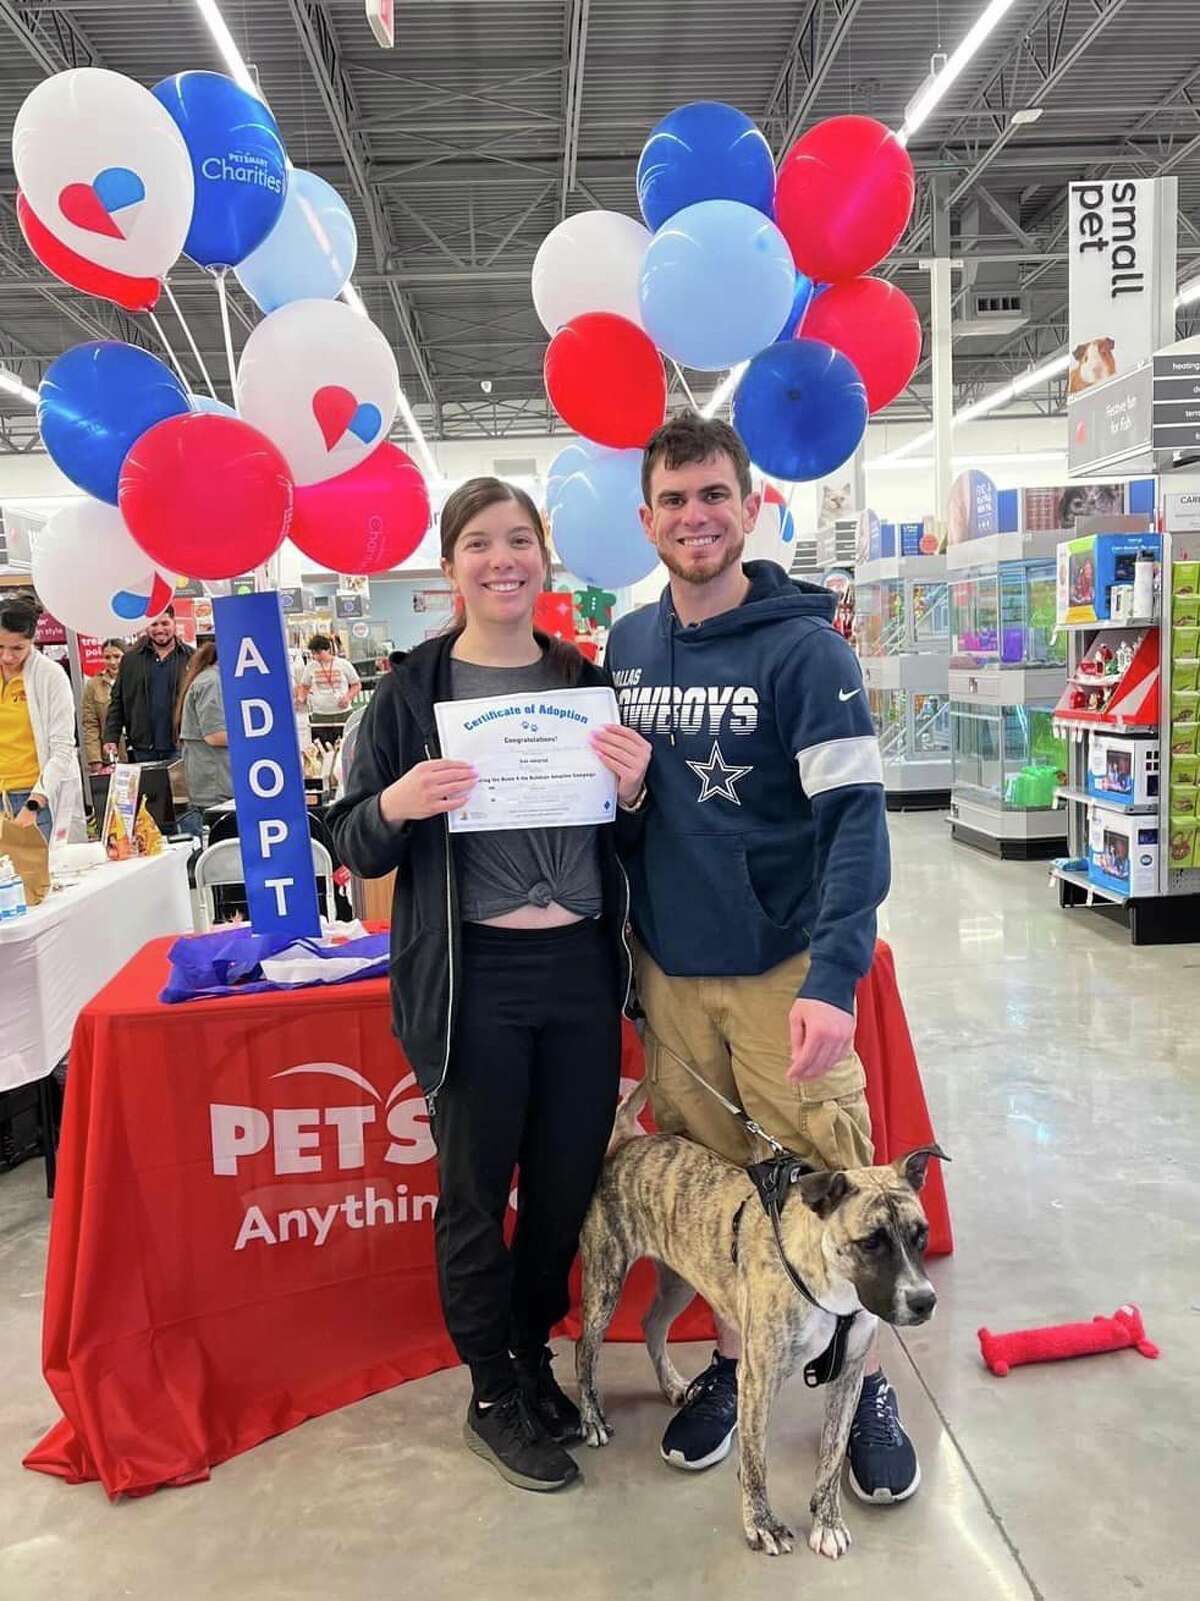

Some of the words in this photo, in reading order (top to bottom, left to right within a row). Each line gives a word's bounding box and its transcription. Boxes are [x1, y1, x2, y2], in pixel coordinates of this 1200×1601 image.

[202, 157, 281, 194] Charities
[1071, 185, 1109, 253] pet
[1111, 182, 1144, 298] small
[612, 668, 643, 687] ALLAS
[464, 706, 521, 731] Certificate
[524, 704, 536, 715] of
[538, 704, 589, 725] Adoption
[618, 686, 759, 736] OWBOYS
[234, 636, 295, 918] ADOPT
[234, 1184, 440, 1251] Anythin
